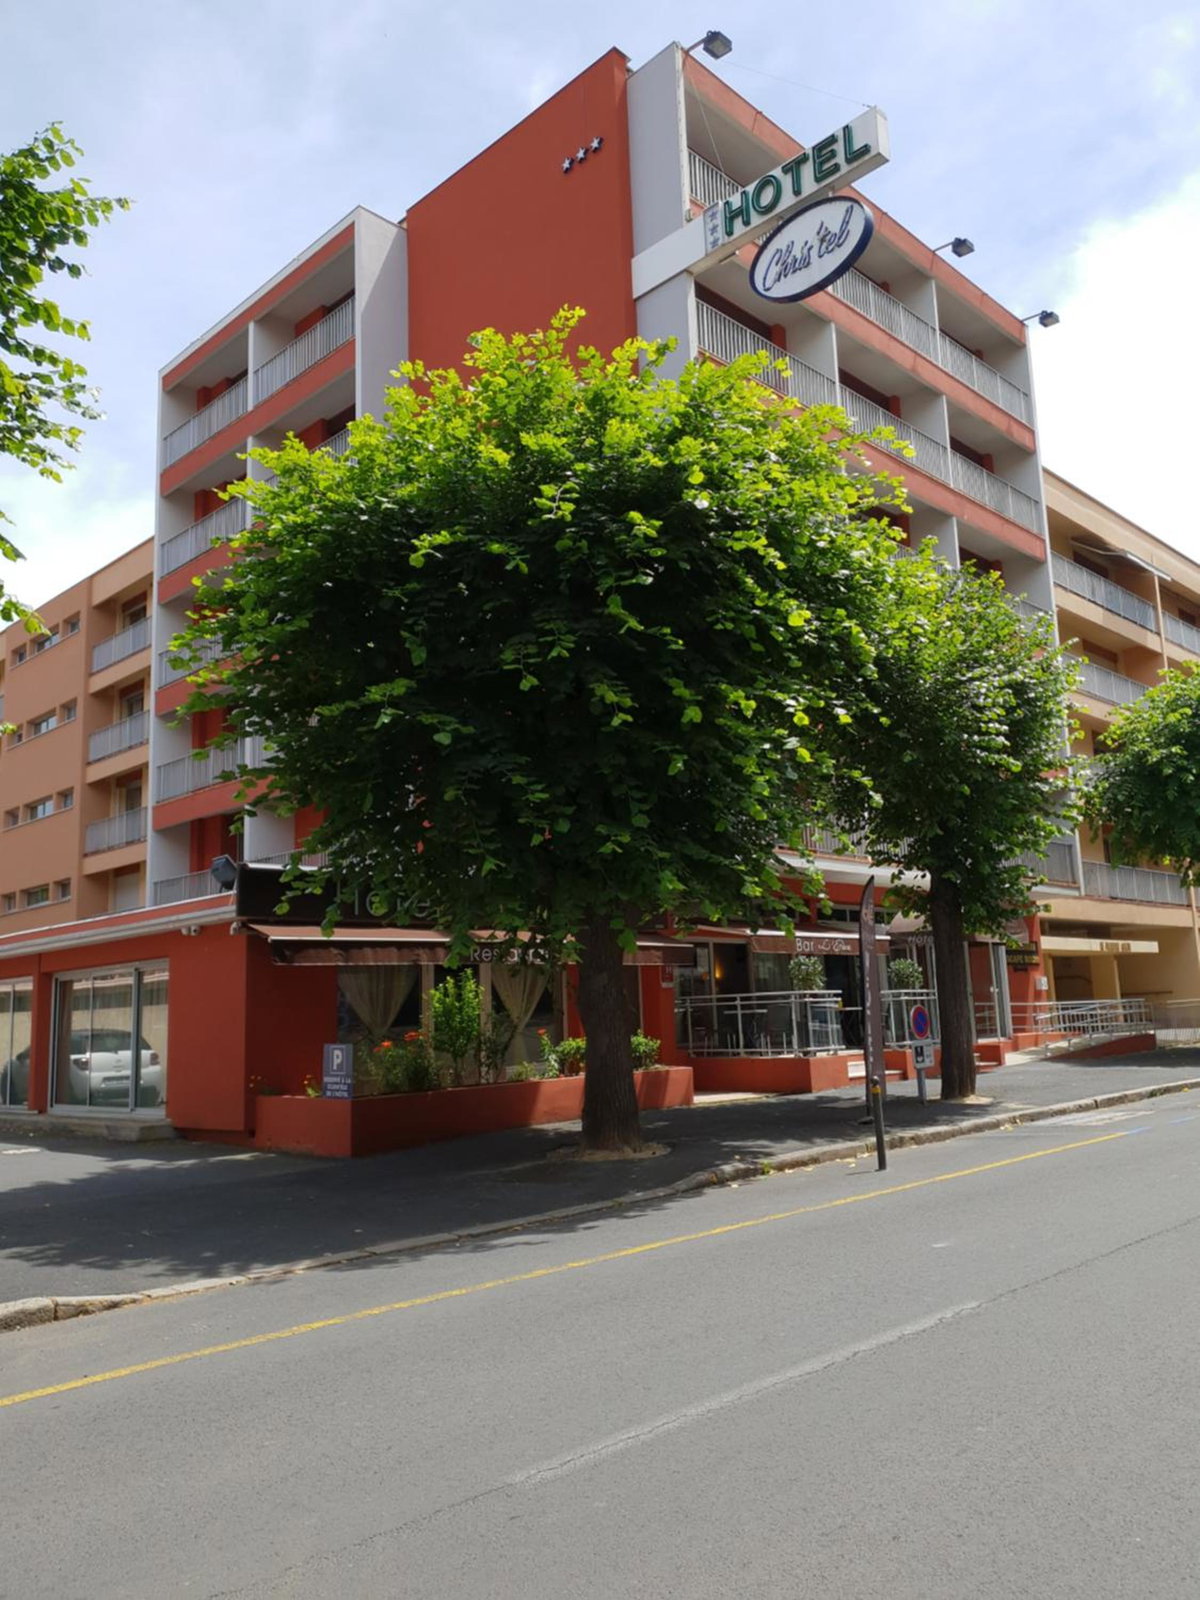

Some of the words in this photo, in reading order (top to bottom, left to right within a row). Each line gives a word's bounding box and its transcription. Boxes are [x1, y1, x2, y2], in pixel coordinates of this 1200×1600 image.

[724, 125, 871, 237] HOTEL
[796, 938, 814, 952] Bar
[332, 1049, 343, 1070] P
